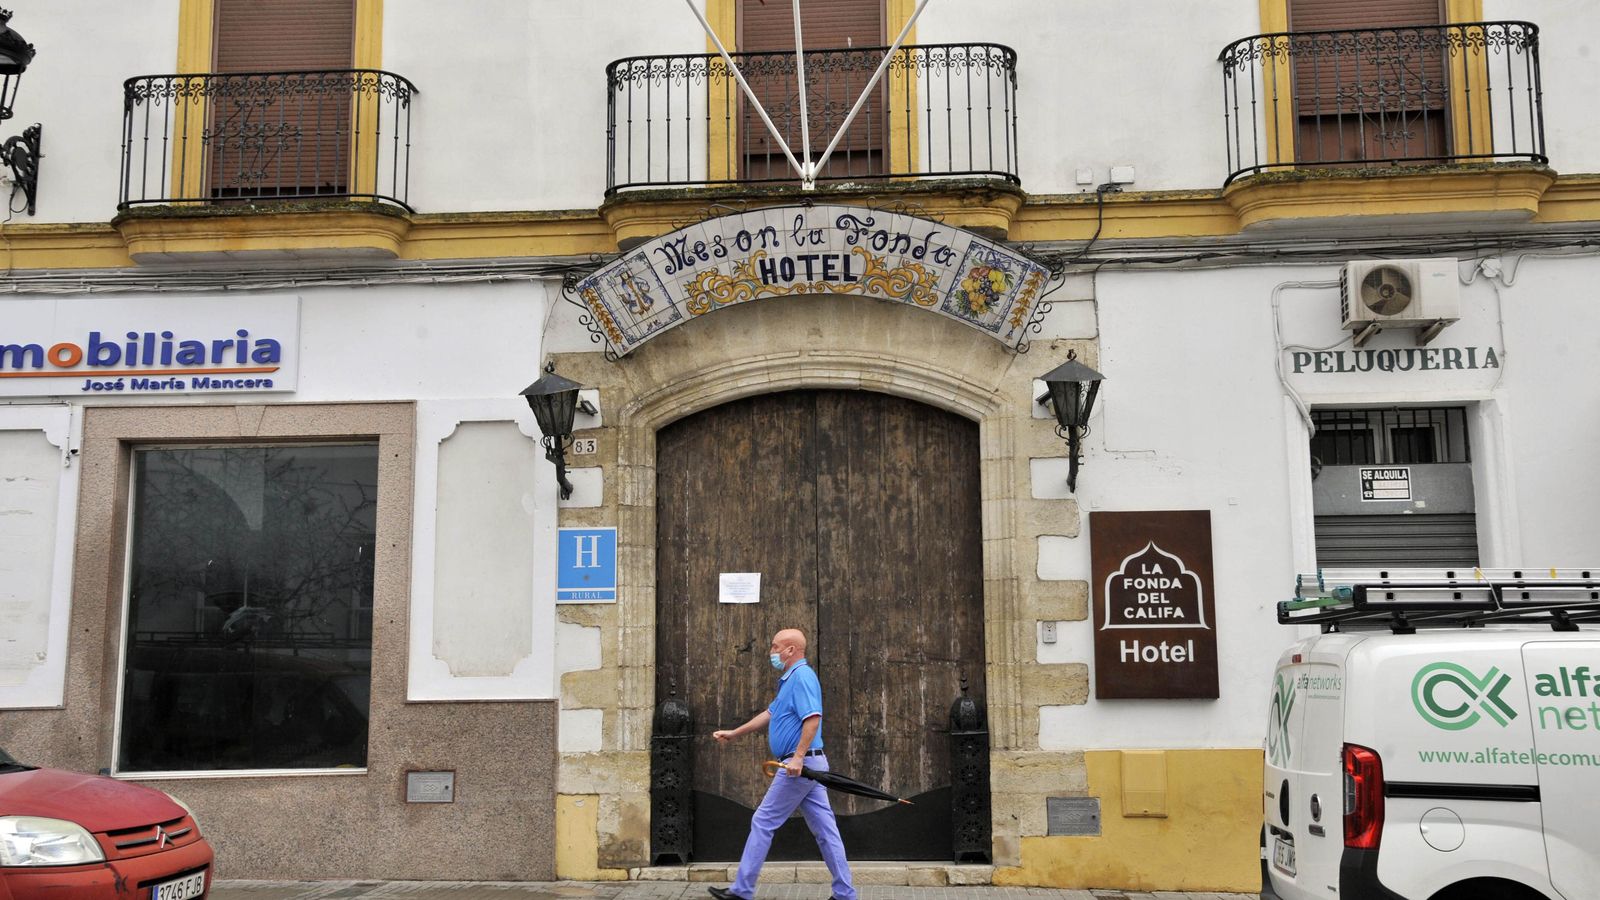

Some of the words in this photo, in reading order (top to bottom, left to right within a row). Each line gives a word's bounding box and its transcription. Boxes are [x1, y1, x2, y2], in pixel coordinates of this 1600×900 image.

[653, 225, 780, 275] Meson
[836, 214, 957, 266] Fonda
[760, 254, 858, 286] HOTEL
[0, 329, 281, 368] mobiliaria
[1291, 346, 1499, 374] PELUQUERIA
[82, 377, 125, 391] José
[130, 377, 185, 390] María
[191, 377, 274, 389] Mancera
[575, 440, 595, 453] 83
[1362, 470, 1373, 480] SE
[1374, 470, 1408, 480] ALQUILA
[572, 535, 602, 568] H
[1141, 563, 1163, 575] LA
[1123, 578, 1182, 590] FONDA
[571, 591, 602, 599] RURAL
[1137, 592, 1170, 604] DEL
[1123, 607, 1185, 619] CALIFA
[1120, 639, 1194, 663] Hotel
[1534, 666, 1600, 697] alf
